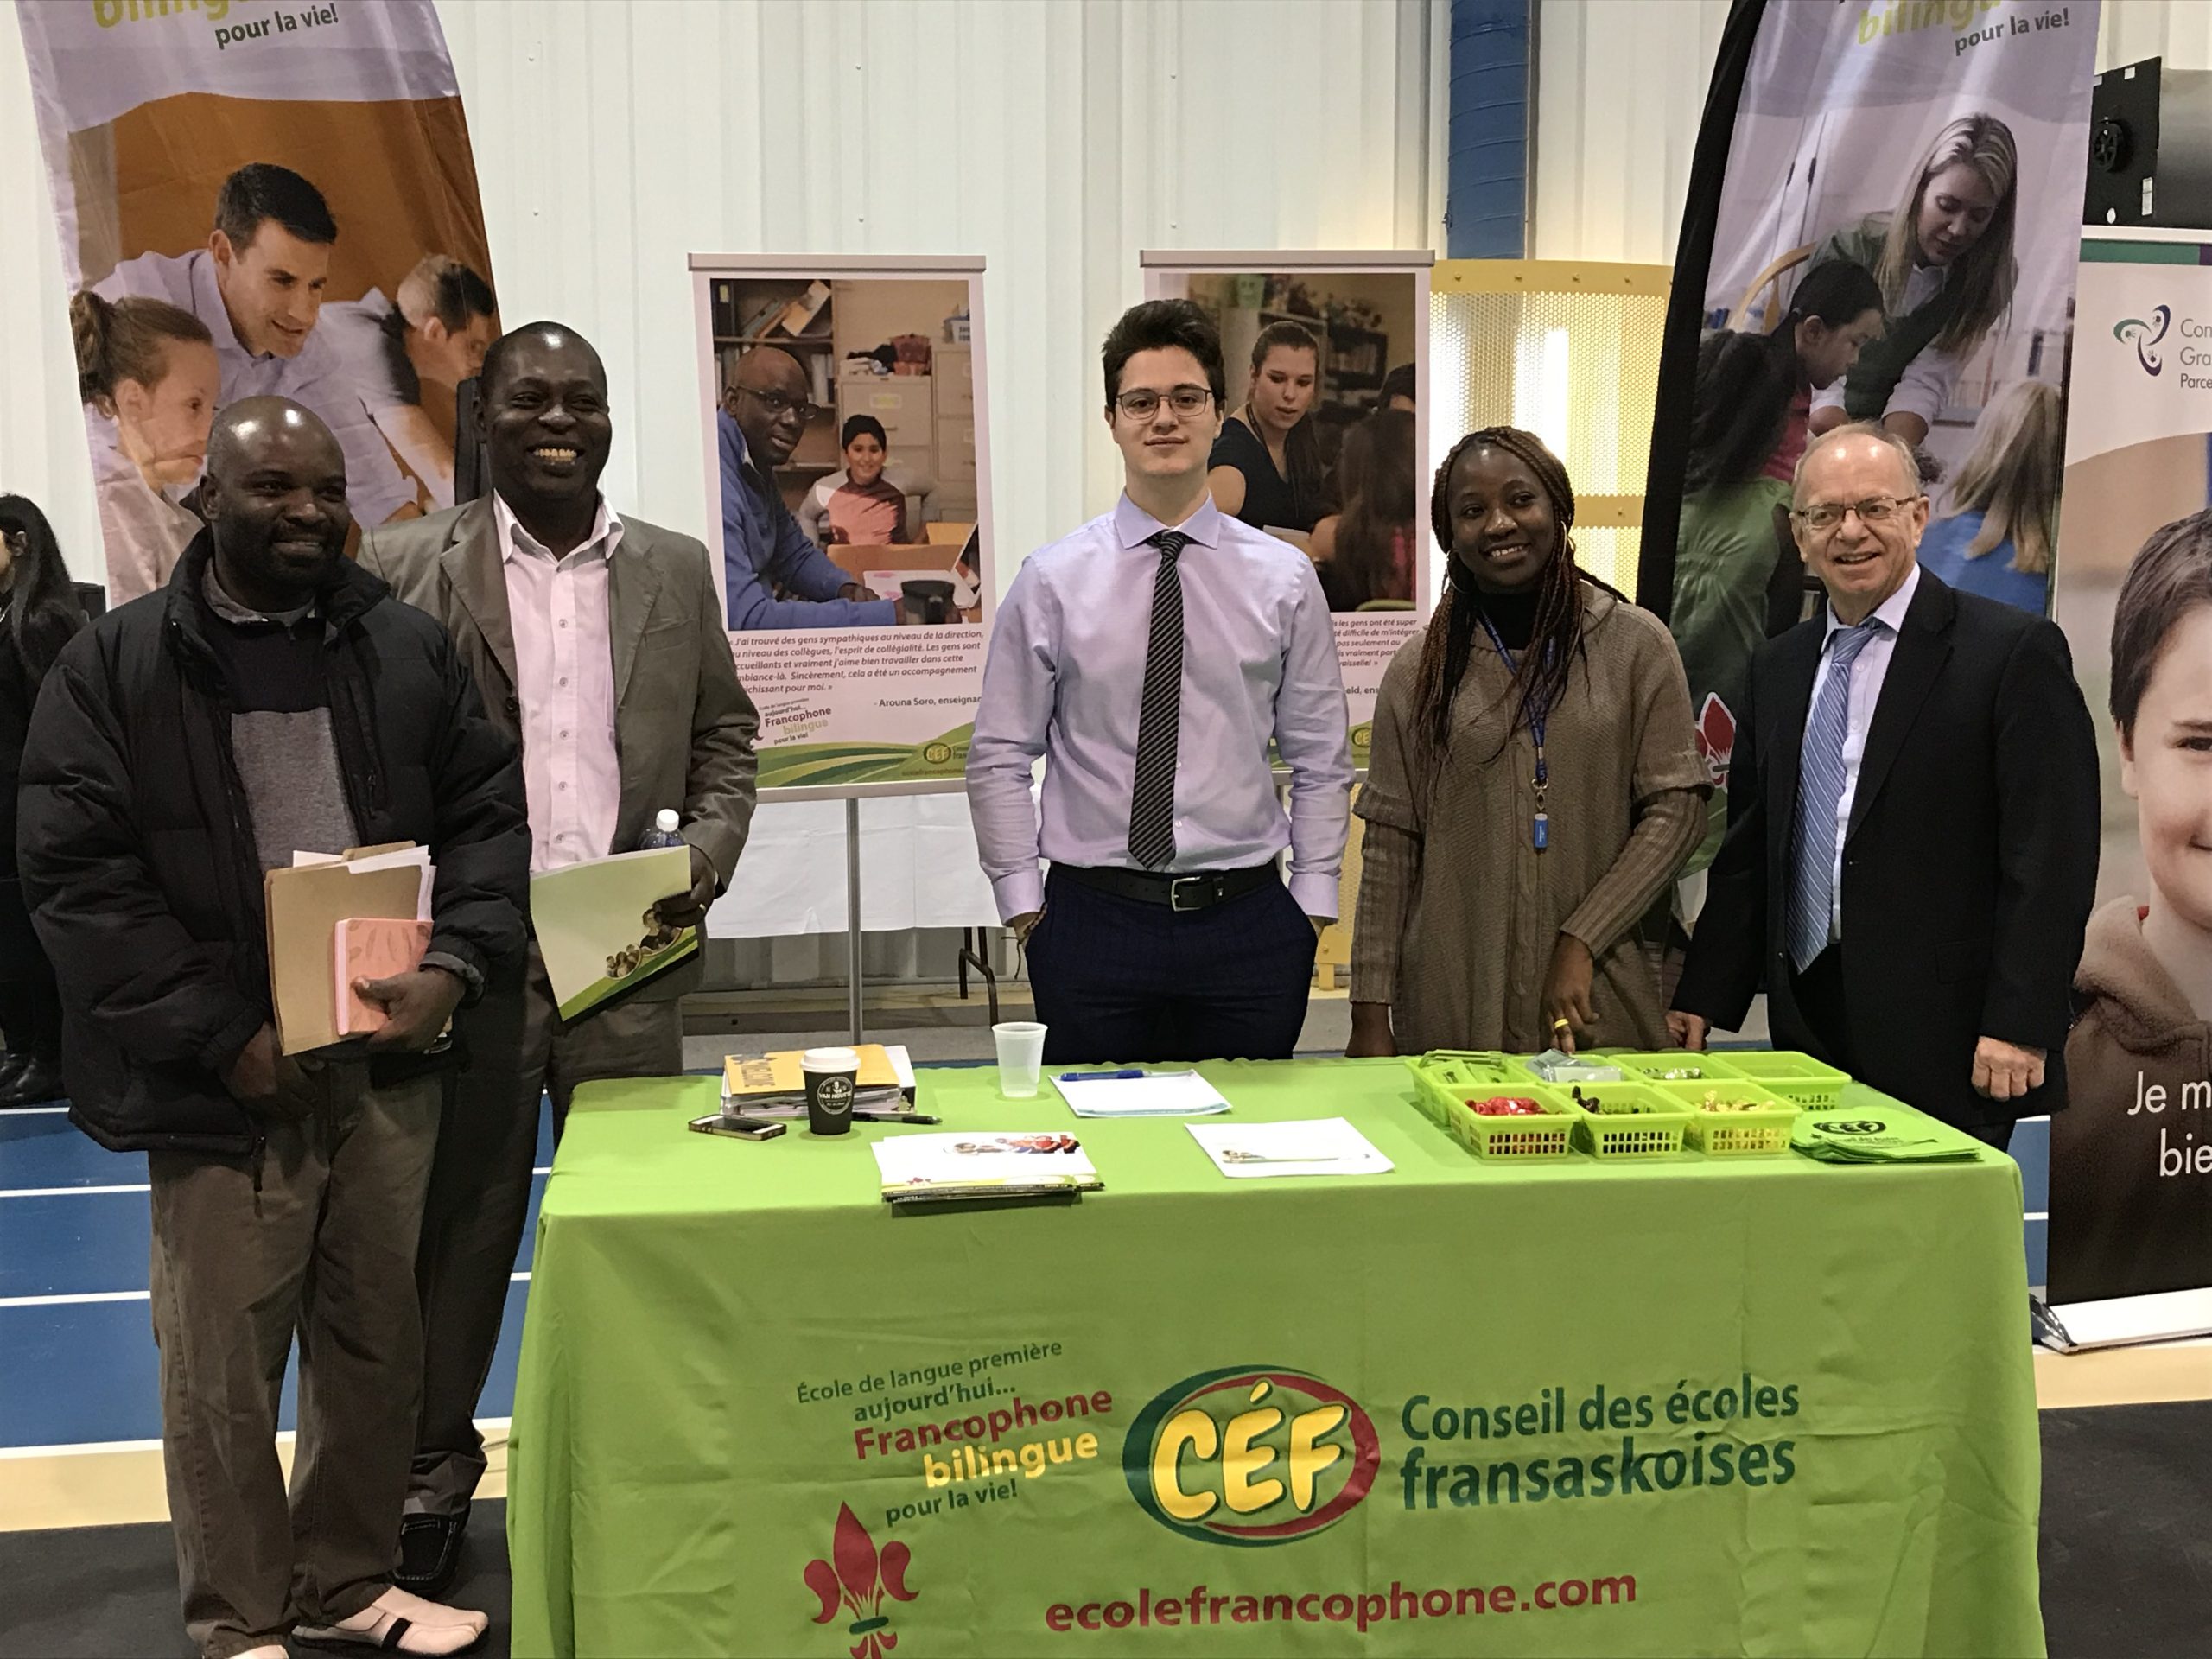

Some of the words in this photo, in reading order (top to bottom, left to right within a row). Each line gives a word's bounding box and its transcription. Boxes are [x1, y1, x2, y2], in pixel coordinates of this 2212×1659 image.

[214, 20, 270, 50] pour
[275, 11, 297, 32] la
[300, 3, 339, 27] vie!
[1955, 23, 2004, 56] pour
[2010, 16, 2030, 35] la
[2034, 7, 2070, 31] vie!
[2180, 346, 2211, 366] Gra
[2180, 372, 2212, 390] Parce
[735, 638, 749, 646] J'ai
[751, 637, 779, 646] trouvé
[781, 636, 796, 645] des
[798, 637, 817, 647] gens
[819, 633, 880, 646] sympathiques
[893, 632, 922, 641] niveau
[923, 631, 933, 639] de
[935, 631, 944, 639] la
[944, 630, 983, 639] direction,
[1396, 619, 1418, 627] super
[735, 661, 782, 671] ccueillants
[794, 659, 832, 668] vraiment
[833, 658, 860, 669] j'aime
[861, 656, 880, 665] bien
[881, 655, 920, 664] travailler
[920, 654, 941, 663] dans
[943, 654, 964, 663] cette
[773, 648, 788, 657] des
[790, 646, 833, 658] collègues,
[834, 645, 862, 657] l'esprit
[864, 645, 874, 654] de
[925, 643, 940, 652] Les
[940, 644, 960, 654] gens
[737, 672, 786, 683] mbiance-là.
[791, 670, 846, 680] Sincèrement,
[848, 669, 865, 677] cela
[874, 668, 887, 677] été
[901, 665, 977, 677] accompagnement
[745, 685, 784, 694] ichissant
[785, 685, 805, 695] pour
[1345, 685, 1363, 696] eid,
[765, 708, 831, 728] Francophone
[879, 698, 912, 708] Arouna
[913, 696, 937, 706] Soro,
[783, 719, 829, 735] bilingue
[2126, 1071, 2167, 1116] Je
[2160, 1128, 2212, 1177] bie
[797, 1380, 854, 1403] École
[859, 1375, 885, 1393] de
[890, 1363, 963, 1387] langue
[969, 1340, 1063, 1377] première
[854, 1377, 1016, 1423] aujourd'hui...
[1402, 1387, 1565, 1440] Conseil
[1579, 1383, 1654, 1431] des
[1666, 1372, 1800, 1425] écoles
[854, 1390, 1114, 1460] Francophone
[923, 1432, 1099, 1488] bilingue
[1154, 1380, 1349, 1521] CÉF
[1400, 1431, 1796, 1510] fransaskoises
[886, 1495, 943, 1528] pour
[947, 1490, 969, 1509] la
[974, 1478, 1018, 1504] vie!
[1045, 1573, 1637, 1633] ecolefrancophone.com
